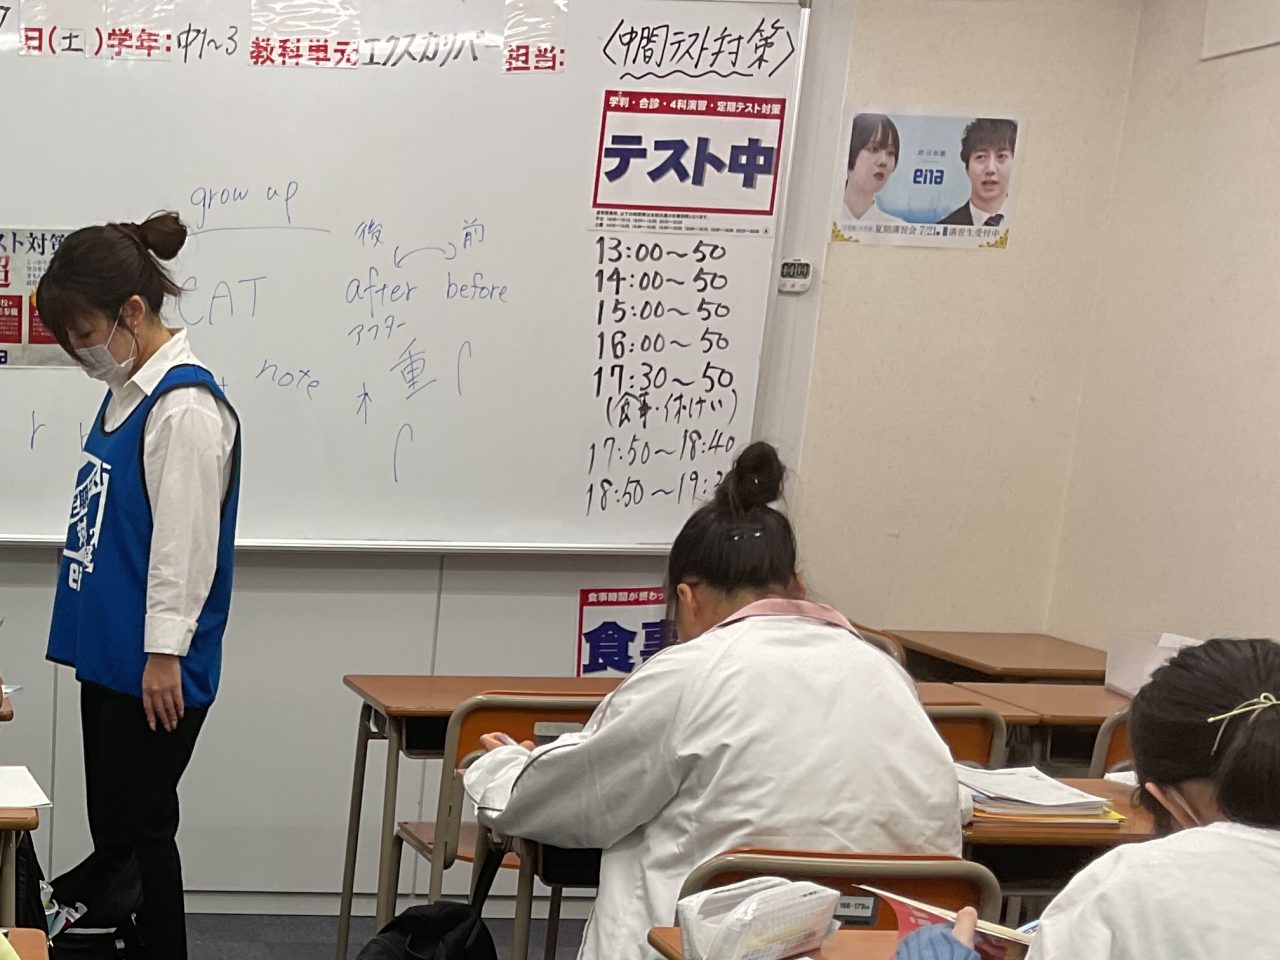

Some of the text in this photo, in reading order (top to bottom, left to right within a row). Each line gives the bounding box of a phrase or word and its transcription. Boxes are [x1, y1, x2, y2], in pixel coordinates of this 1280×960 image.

[249, 36, 360, 67] 教科単元
[604, 134, 775, 189] テスト中
[912, 168, 945, 185] ena
[190, 181, 298, 230] grow up
[355, 217, 485, 249] 後 前
[177, 276, 268, 326] CAT
[345, 266, 510, 319] after before
[255, 358, 320, 400] note
[388, 337, 437, 401] 重
